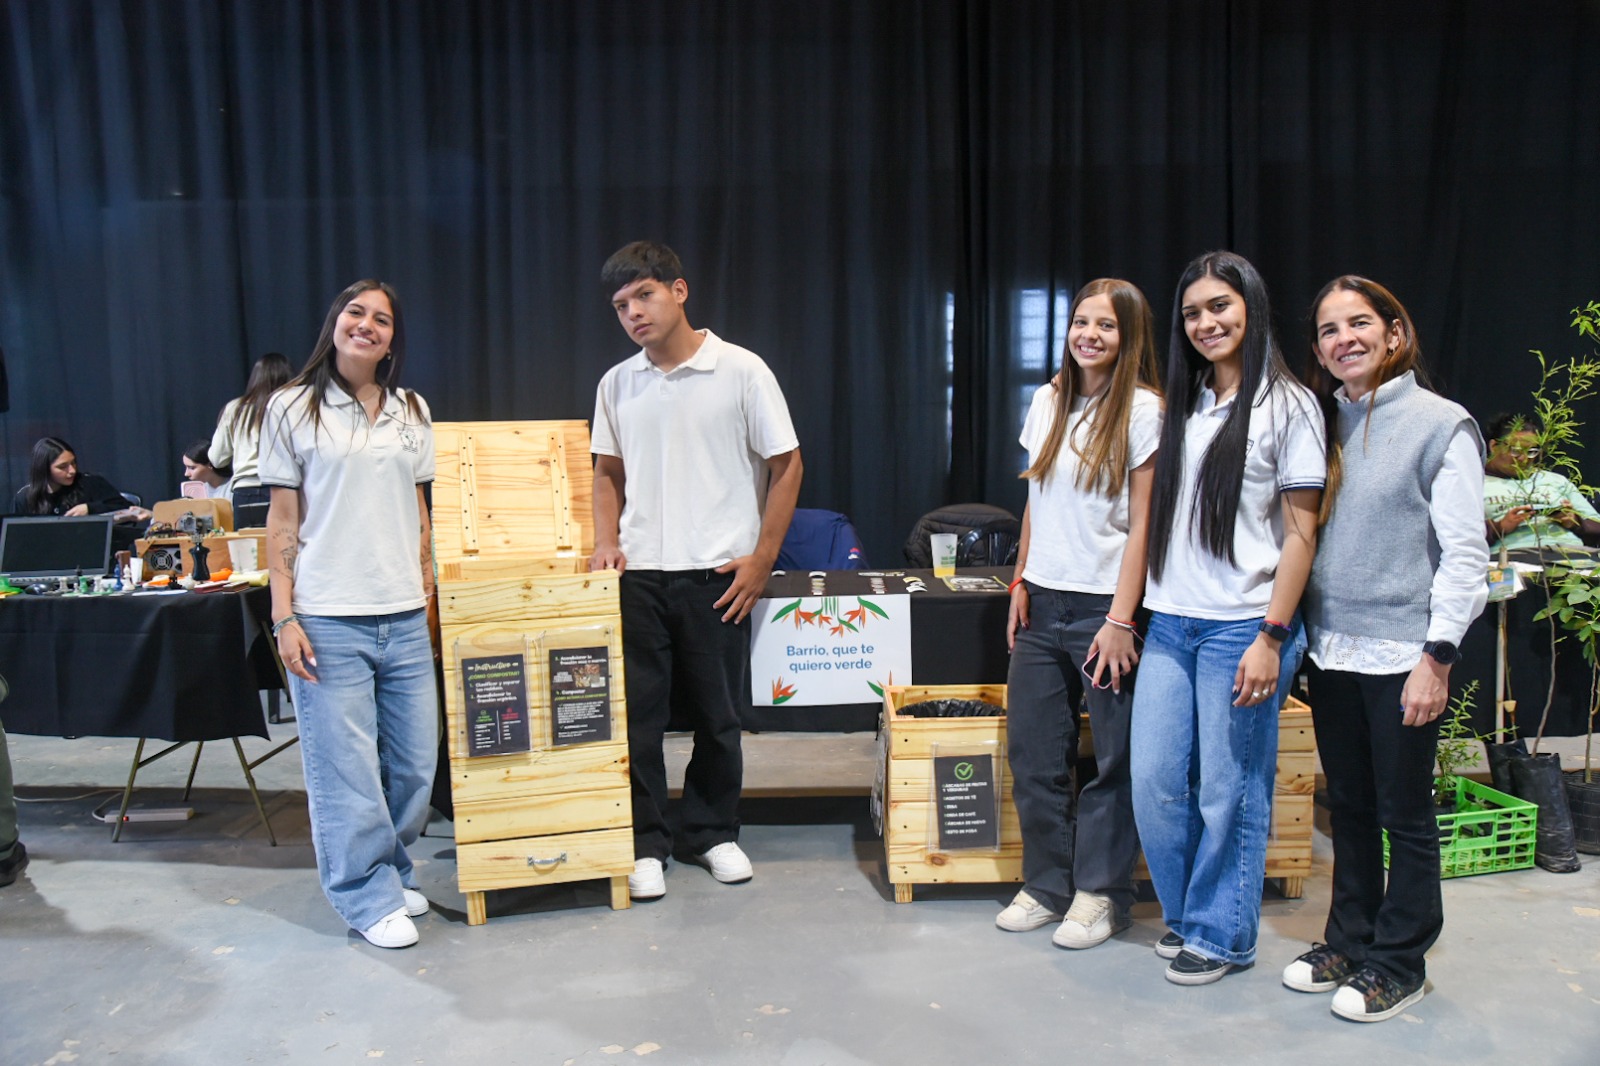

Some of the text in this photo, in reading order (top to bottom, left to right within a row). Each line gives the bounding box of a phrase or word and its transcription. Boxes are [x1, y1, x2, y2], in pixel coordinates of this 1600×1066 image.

[787, 643, 874, 657] Barrio, que te
[475, 662, 511, 672] Instructivo
[789, 658, 872, 674] quiero verde
